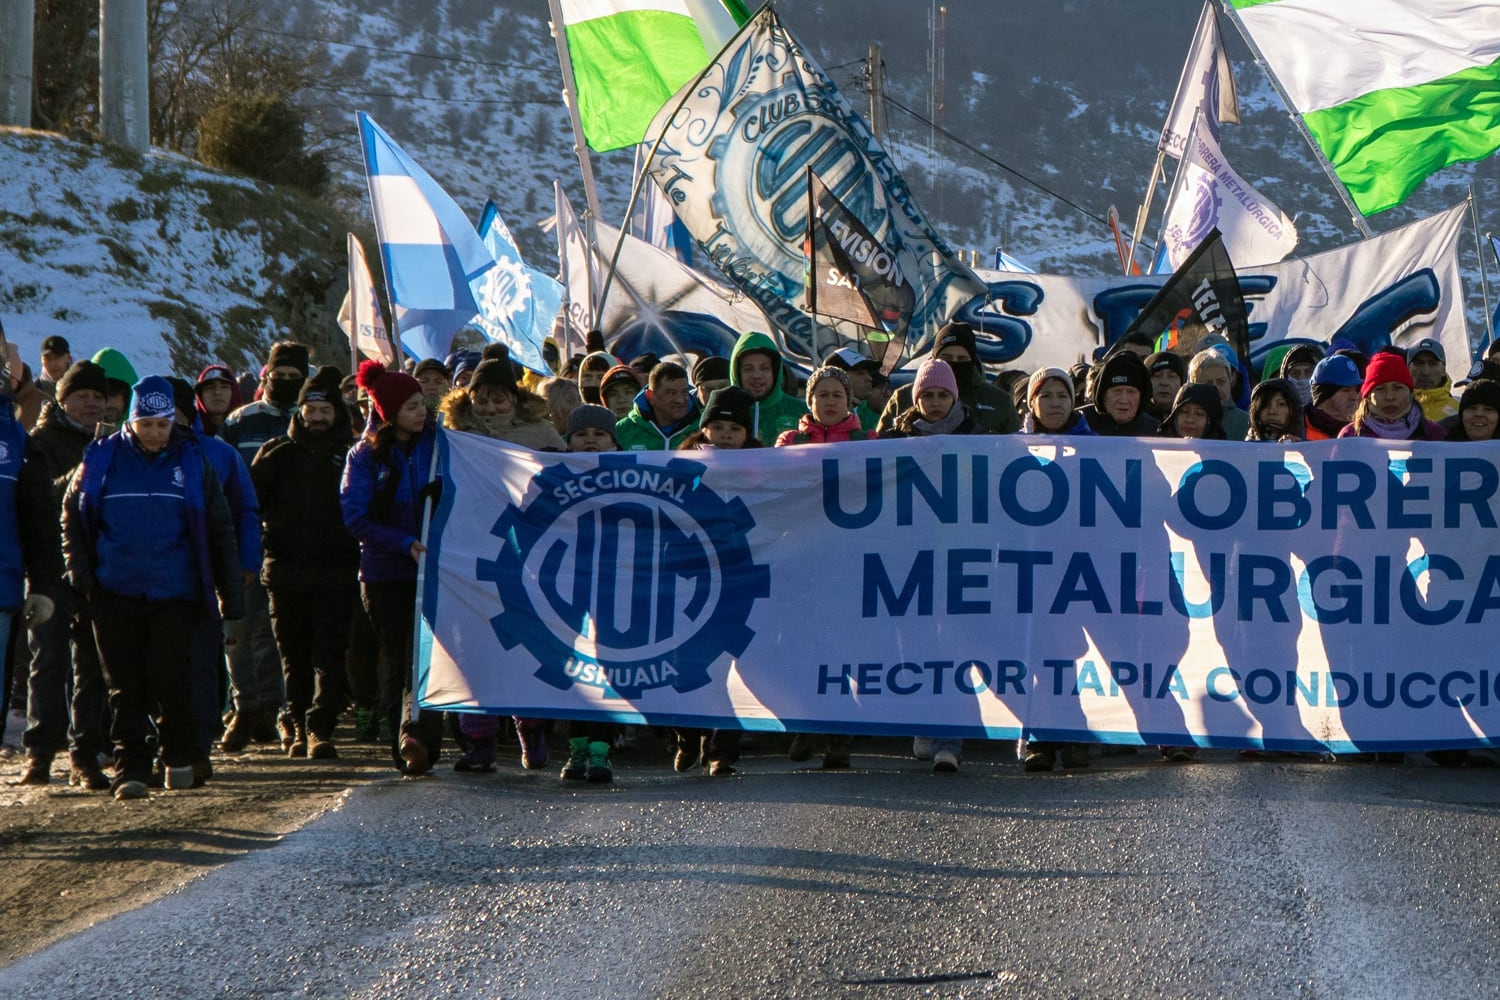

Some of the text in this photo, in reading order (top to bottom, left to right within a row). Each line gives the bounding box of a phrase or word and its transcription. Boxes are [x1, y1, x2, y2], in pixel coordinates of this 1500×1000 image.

[741, 93, 800, 143] CLUB
[665, 164, 693, 206] Te
[553, 468, 686, 507] SECCIONAL
[822, 452, 1142, 530] UNION
[565, 656, 679, 689] USHUAIA
[817, 659, 1027, 696] HECTOR
[1044, 658, 1190, 700] TAPIA
